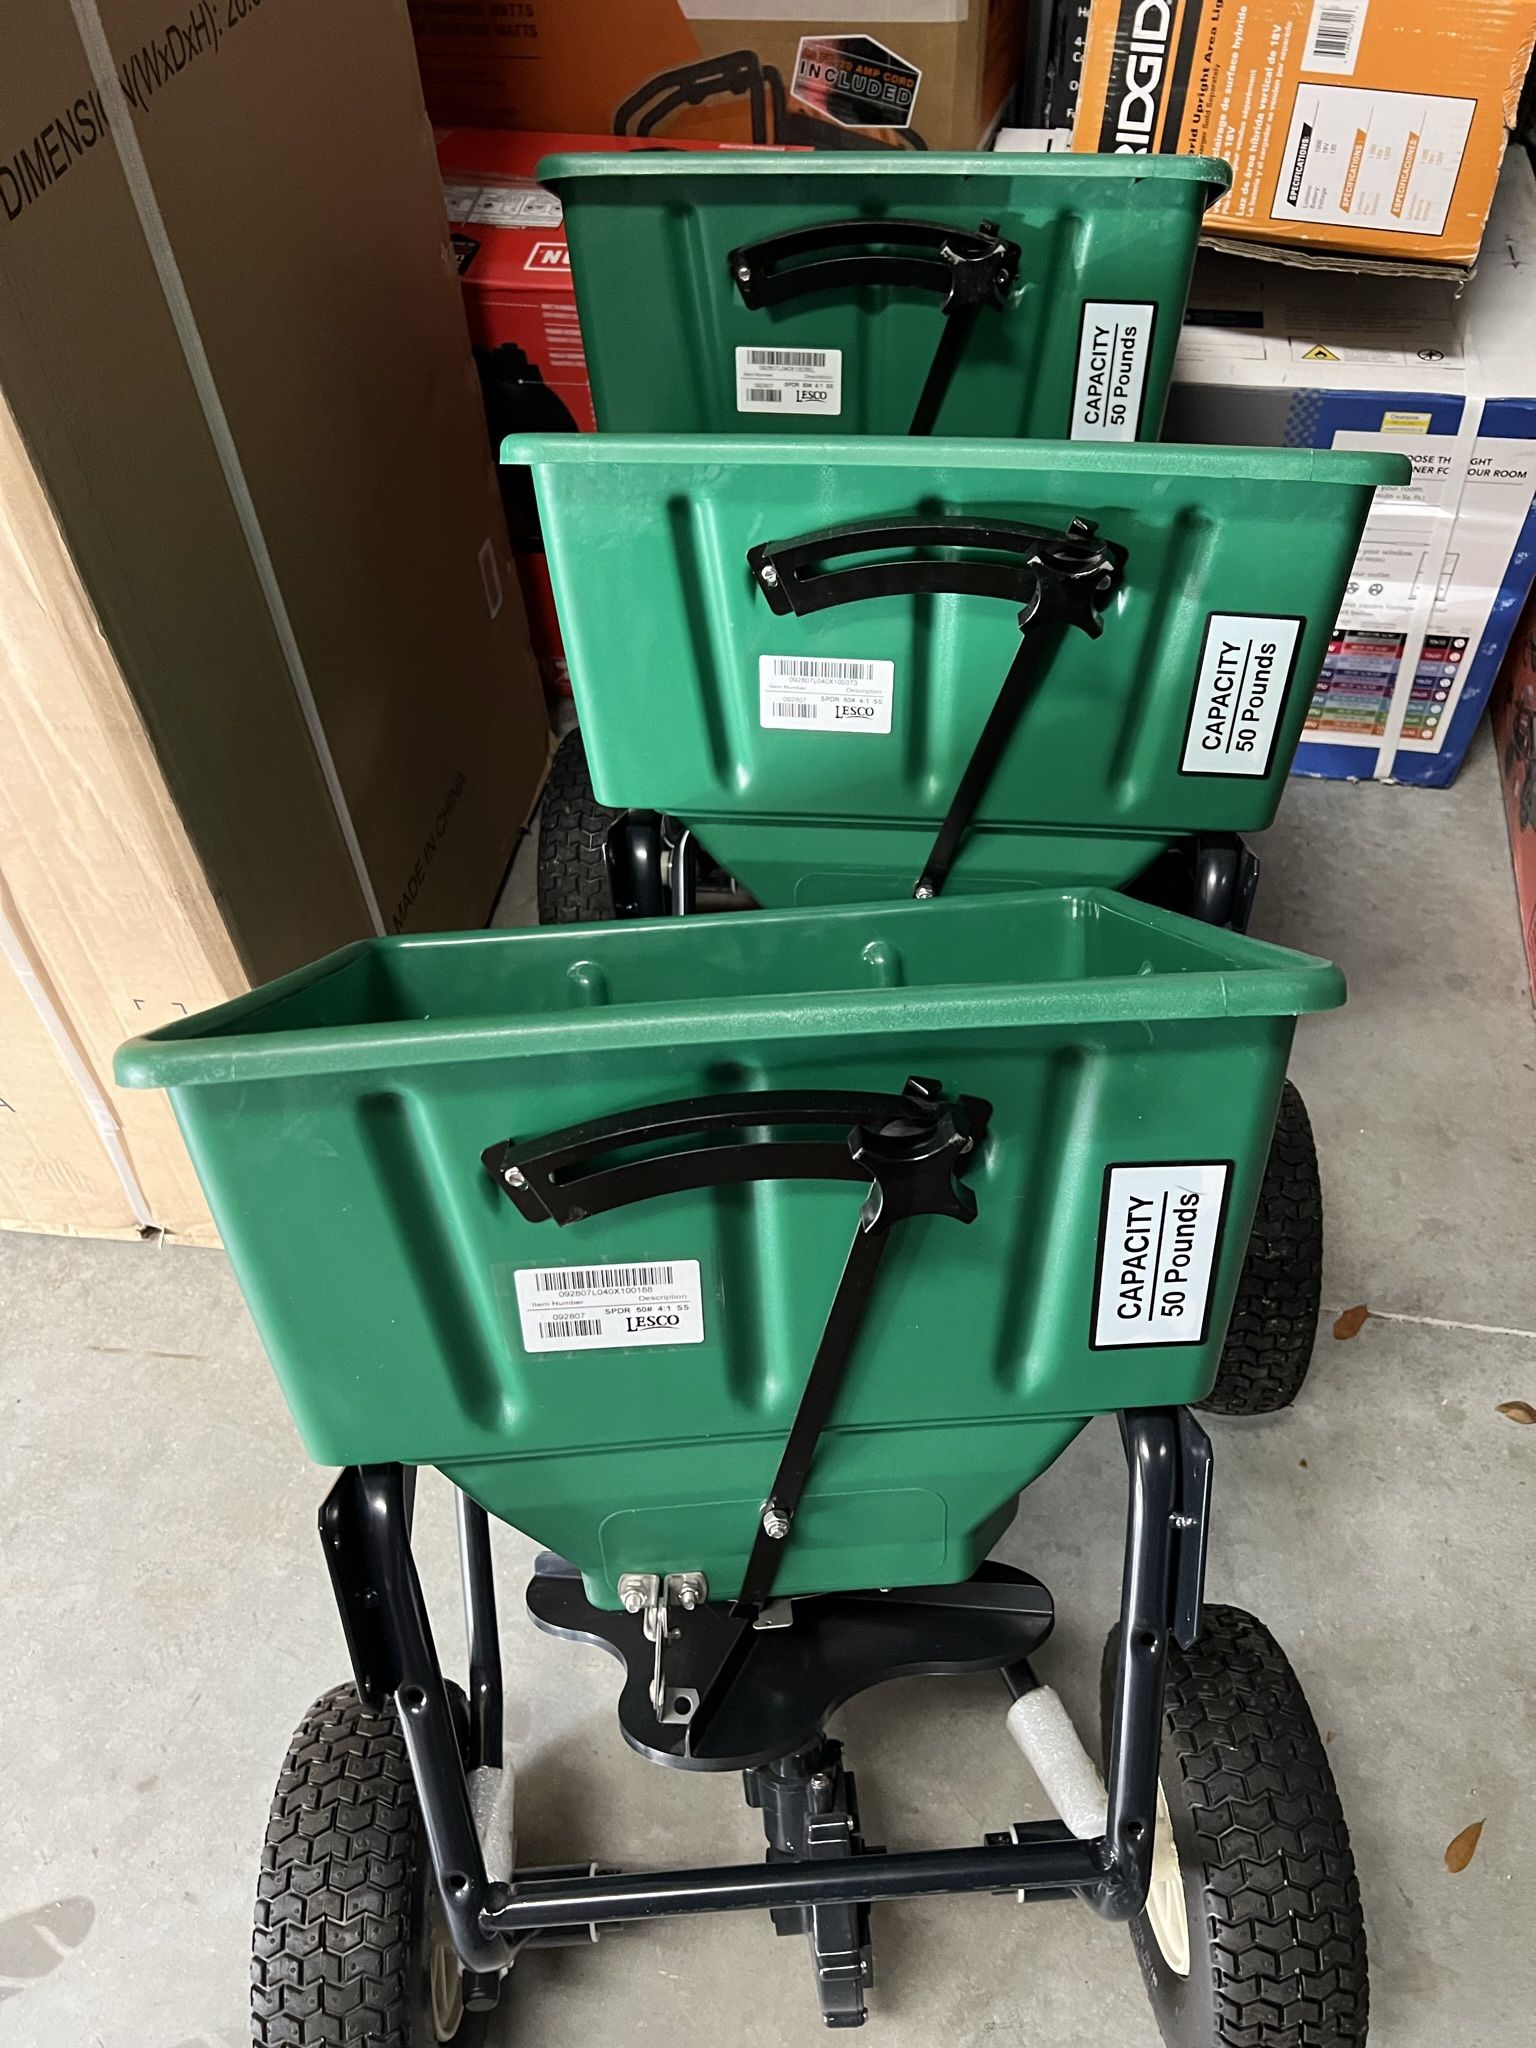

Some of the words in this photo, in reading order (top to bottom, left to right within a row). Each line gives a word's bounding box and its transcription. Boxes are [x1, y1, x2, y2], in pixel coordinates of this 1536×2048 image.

[1232, 6, 1248, 49] hybride
[800, 59, 913, 105] INCLUDED
[1114, 0, 1171, 154] IDGID
[1192, 68, 1209, 123] Upright
[1204, 27, 1217, 63] Area
[1084, 326, 1109, 424] CAPACITY
[1113, 326, 1137, 397] Pounds
[796, 390, 827, 402] LESCO
[1111, 404, 1126, 425] 50
[1412, 466, 1434, 474] NER
[1467, 468, 1491, 477] OUR
[1493, 470, 1527, 479] ROOM
[1470, 458, 1493, 466] GHT
[1202, 641, 1241, 750] CAPACITY
[1241, 643, 1277, 722] Pounds
[835, 705, 874, 719] LESCO
[1235, 729, 1257, 752] 50
[1164, 1193, 1200, 1283] Pounds
[1117, 1196, 1154, 1319] CAPACITY
[552, 1299, 584, 1307] Number
[638, 1293, 688, 1302] Description
[552, 1312, 586, 1320] 092807
[605, 1307, 631, 1315] SPDR
[1161, 1291, 1186, 1317] 50
[626, 1314, 680, 1332] LESCO
